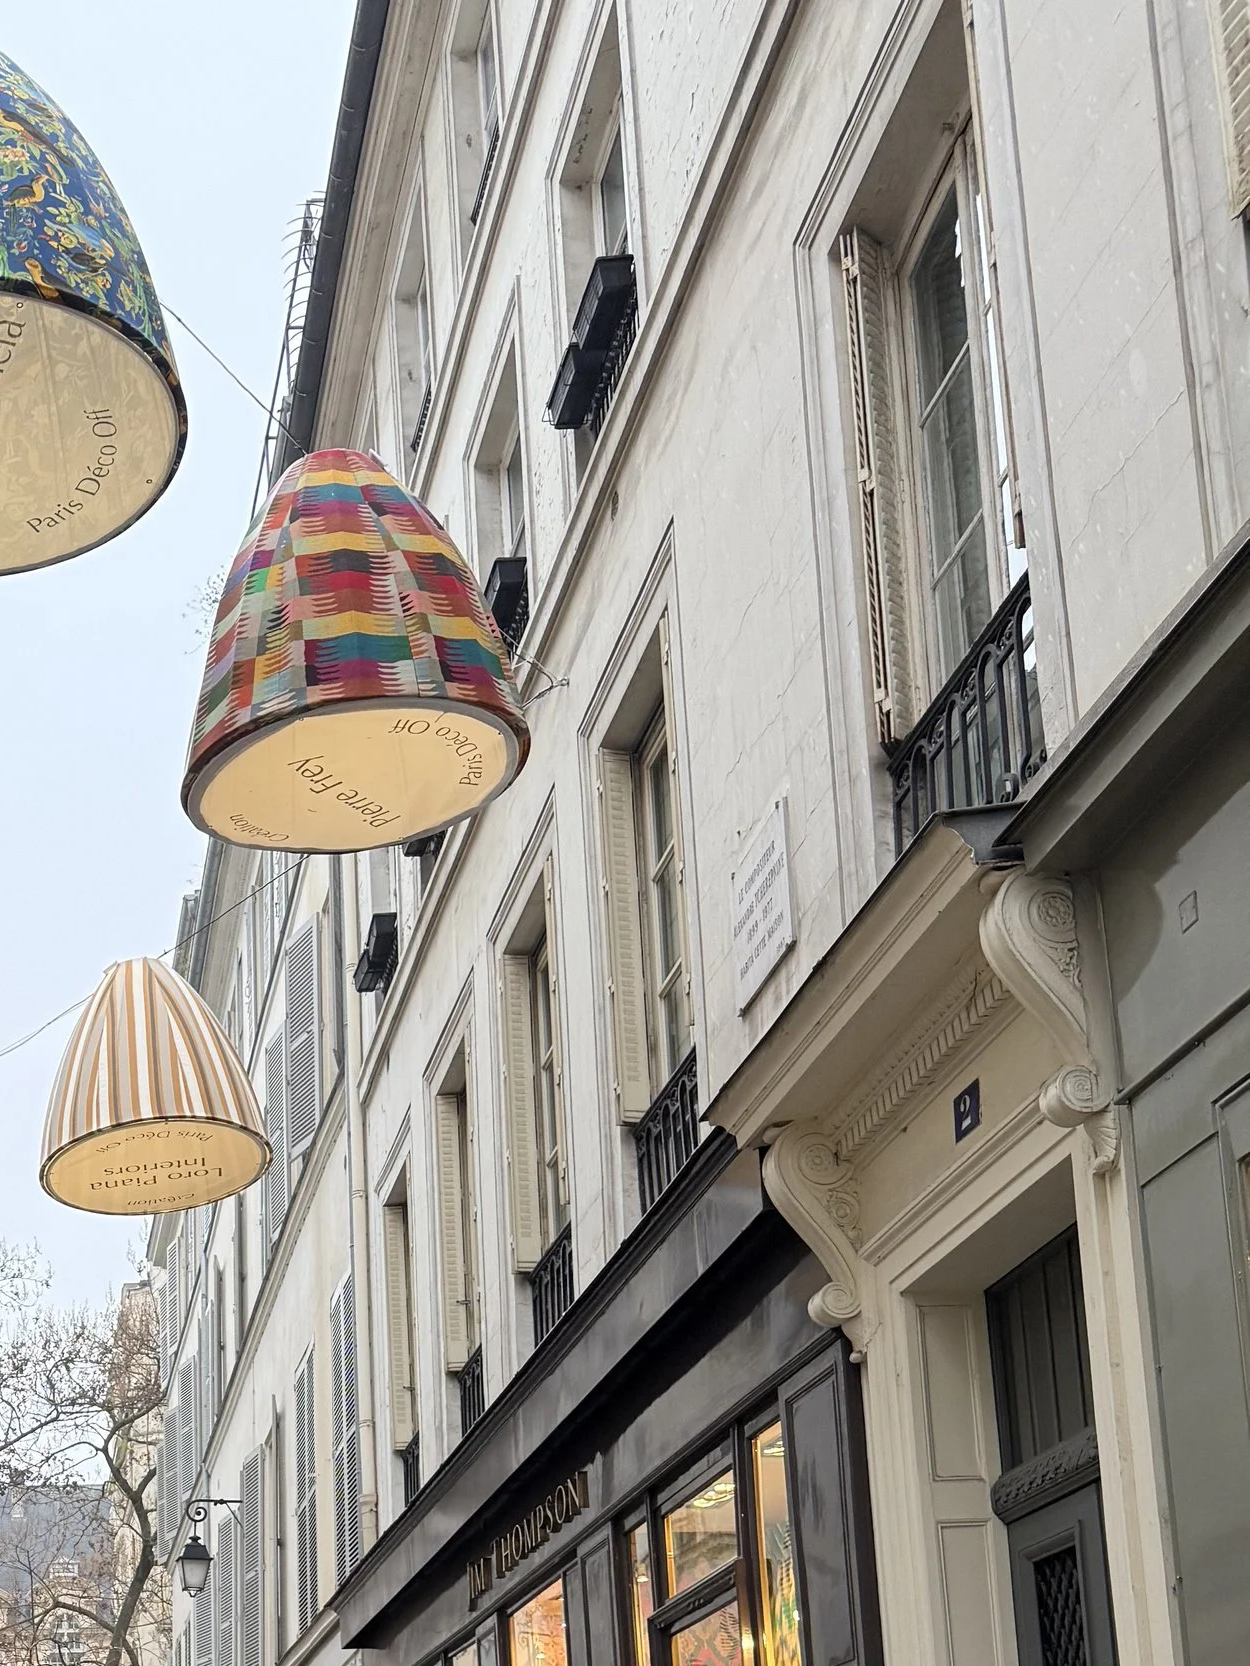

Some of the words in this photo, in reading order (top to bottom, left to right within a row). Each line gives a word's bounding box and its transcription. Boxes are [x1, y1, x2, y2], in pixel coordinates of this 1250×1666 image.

[82, 408, 117, 438] Off
[75, 445, 118, 496] Déco
[26, 498, 84, 533] Paris
[388, 718, 430, 735] Off
[436, 725, 478, 757] Déco
[287, 754, 343, 795] Frey
[459, 753, 483, 786] Paris
[336, 788, 402, 828] Pierre
[229, 813, 290, 842] Création
[960, 1094, 971, 1130] 2
[178, 1130, 214, 1142] Paris
[104, 1157, 206, 1176] Interiors
[168, 1167, 223, 1180] Loro
[89, 1175, 158, 1191] Piana
[490, 1471, 582, 1578] THOMPSON
